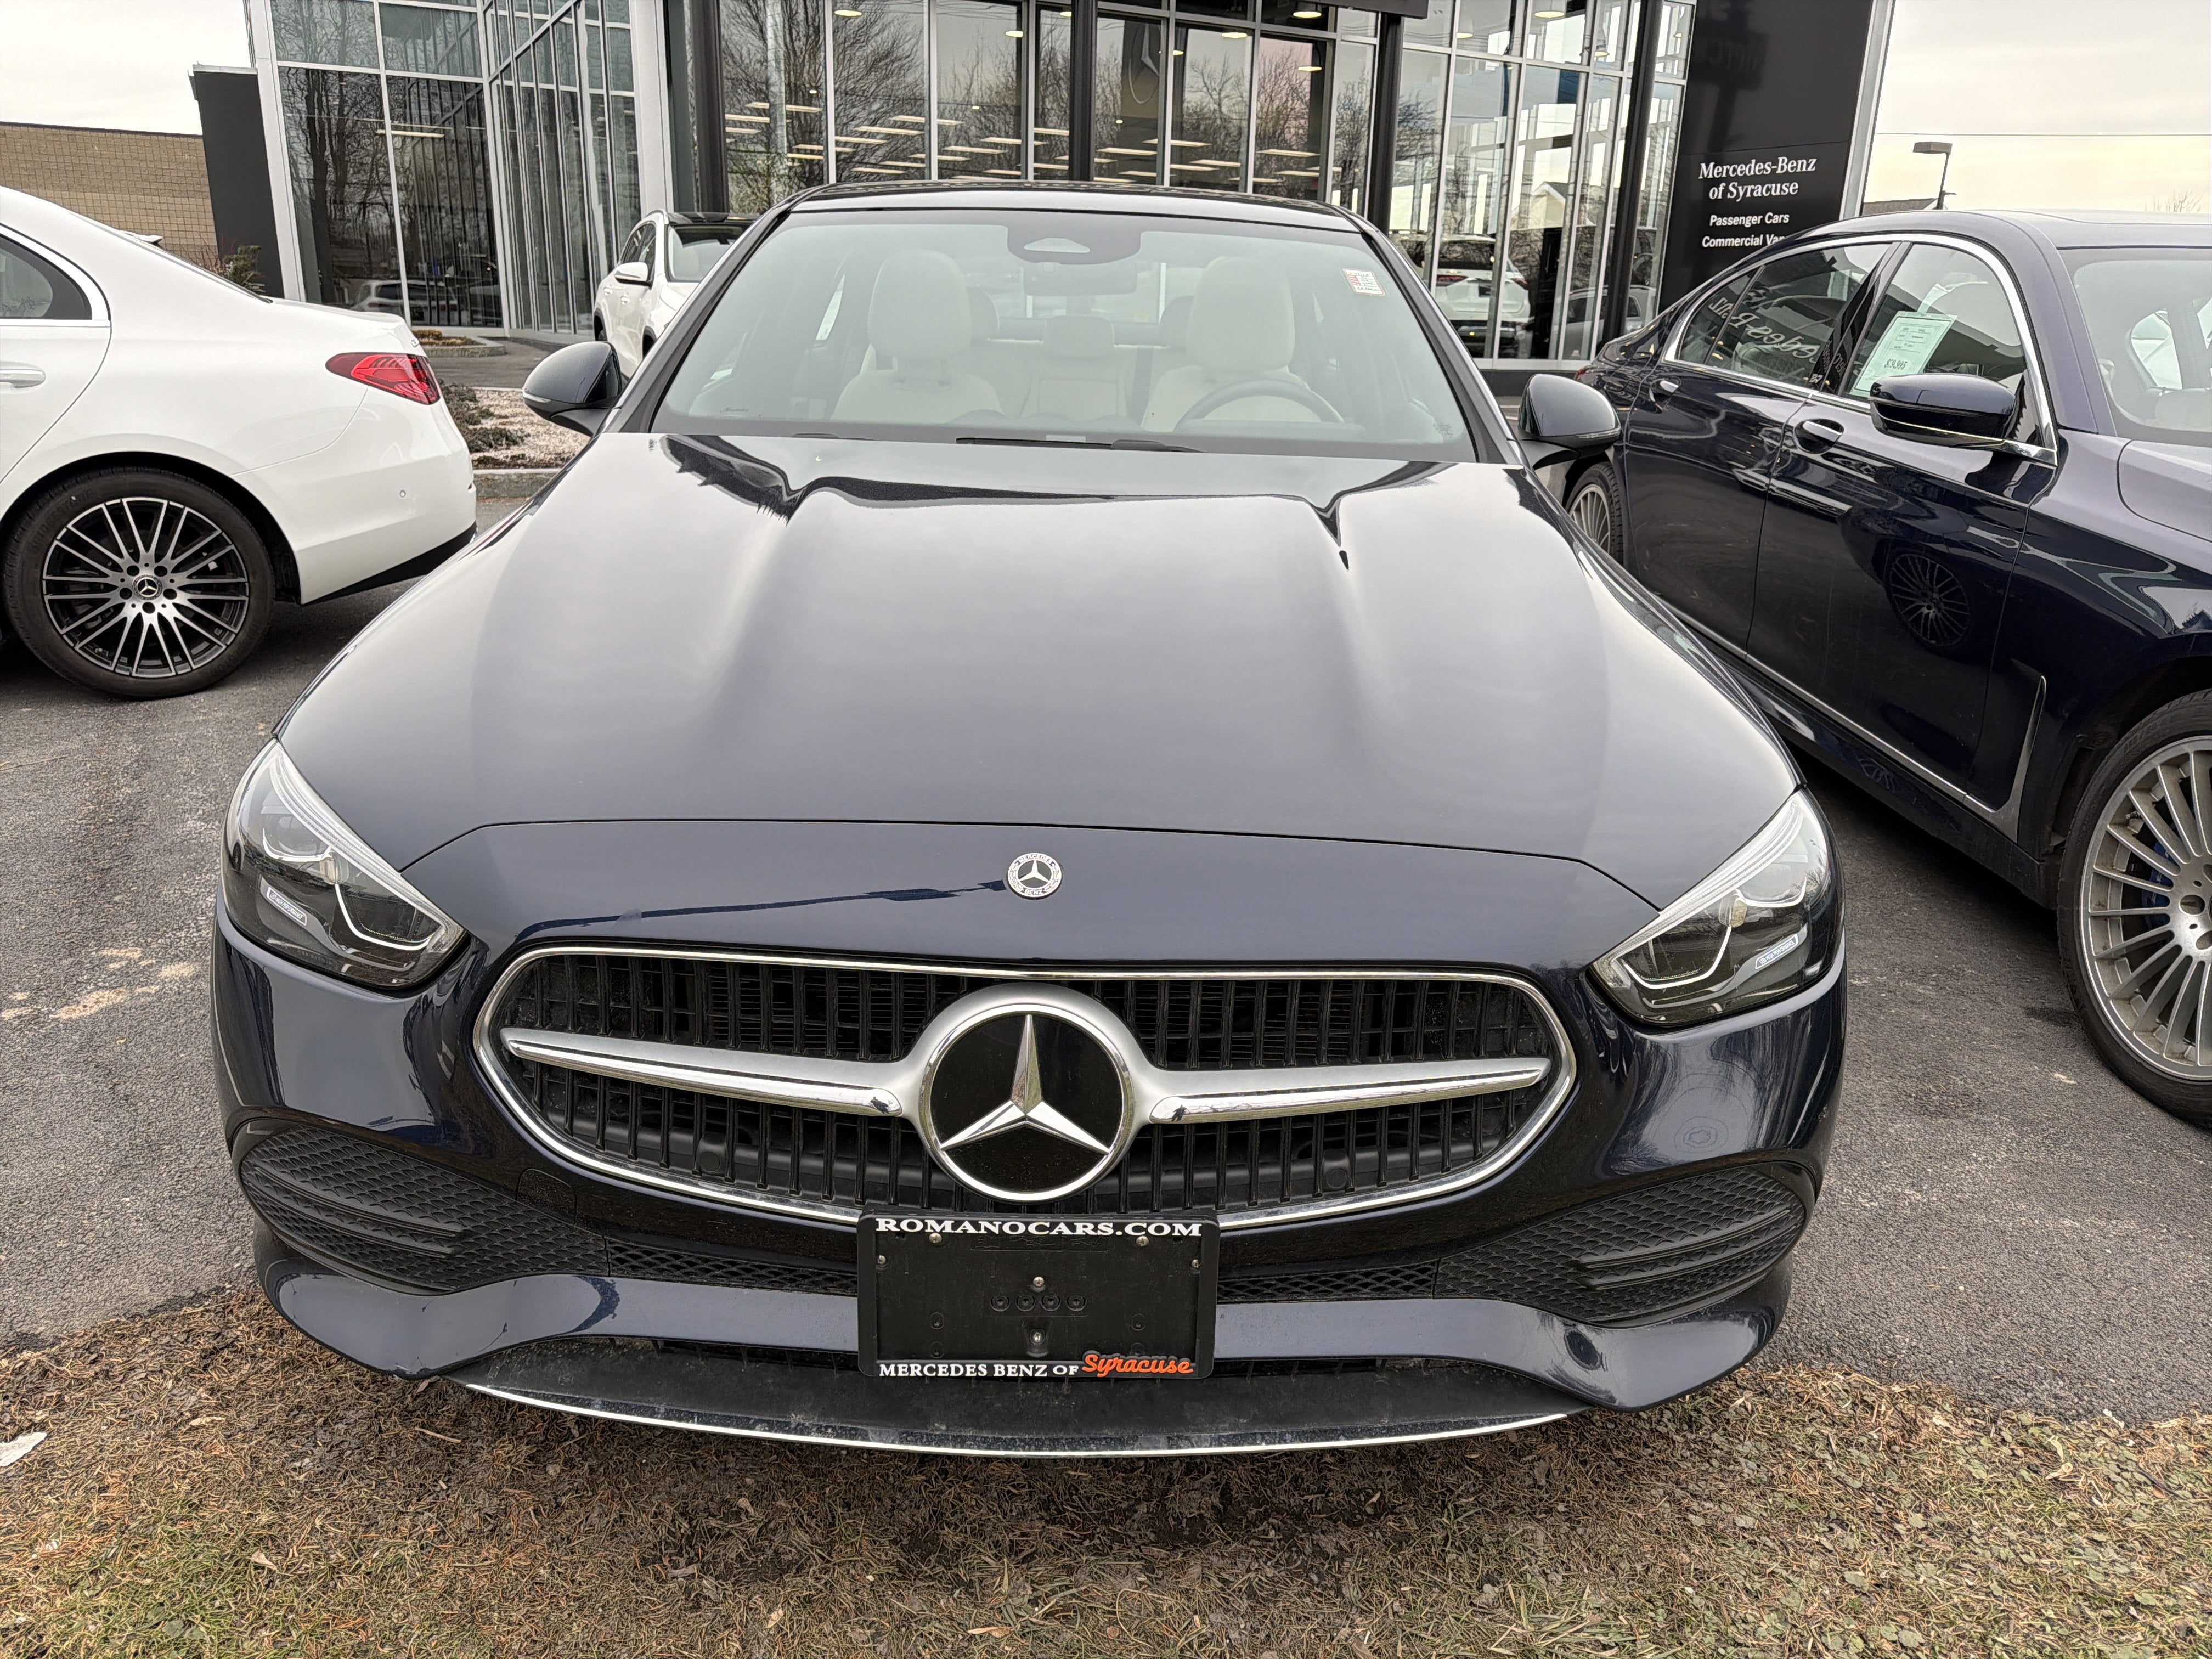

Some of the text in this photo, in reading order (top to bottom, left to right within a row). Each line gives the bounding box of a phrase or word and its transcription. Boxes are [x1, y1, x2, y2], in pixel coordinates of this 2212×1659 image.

[1699, 157, 1817, 179] Mercedes-Benz
[1709, 182, 1799, 202] of Syracuse
[1709, 212, 1790, 228] Passenger Cars
[1702, 234, 1763, 247] Commercial
[875, 1218, 1202, 1237] ROMANOCARS.COM
[879, 1354, 1194, 1378] MERCEDES BENZ OF Syracuse
